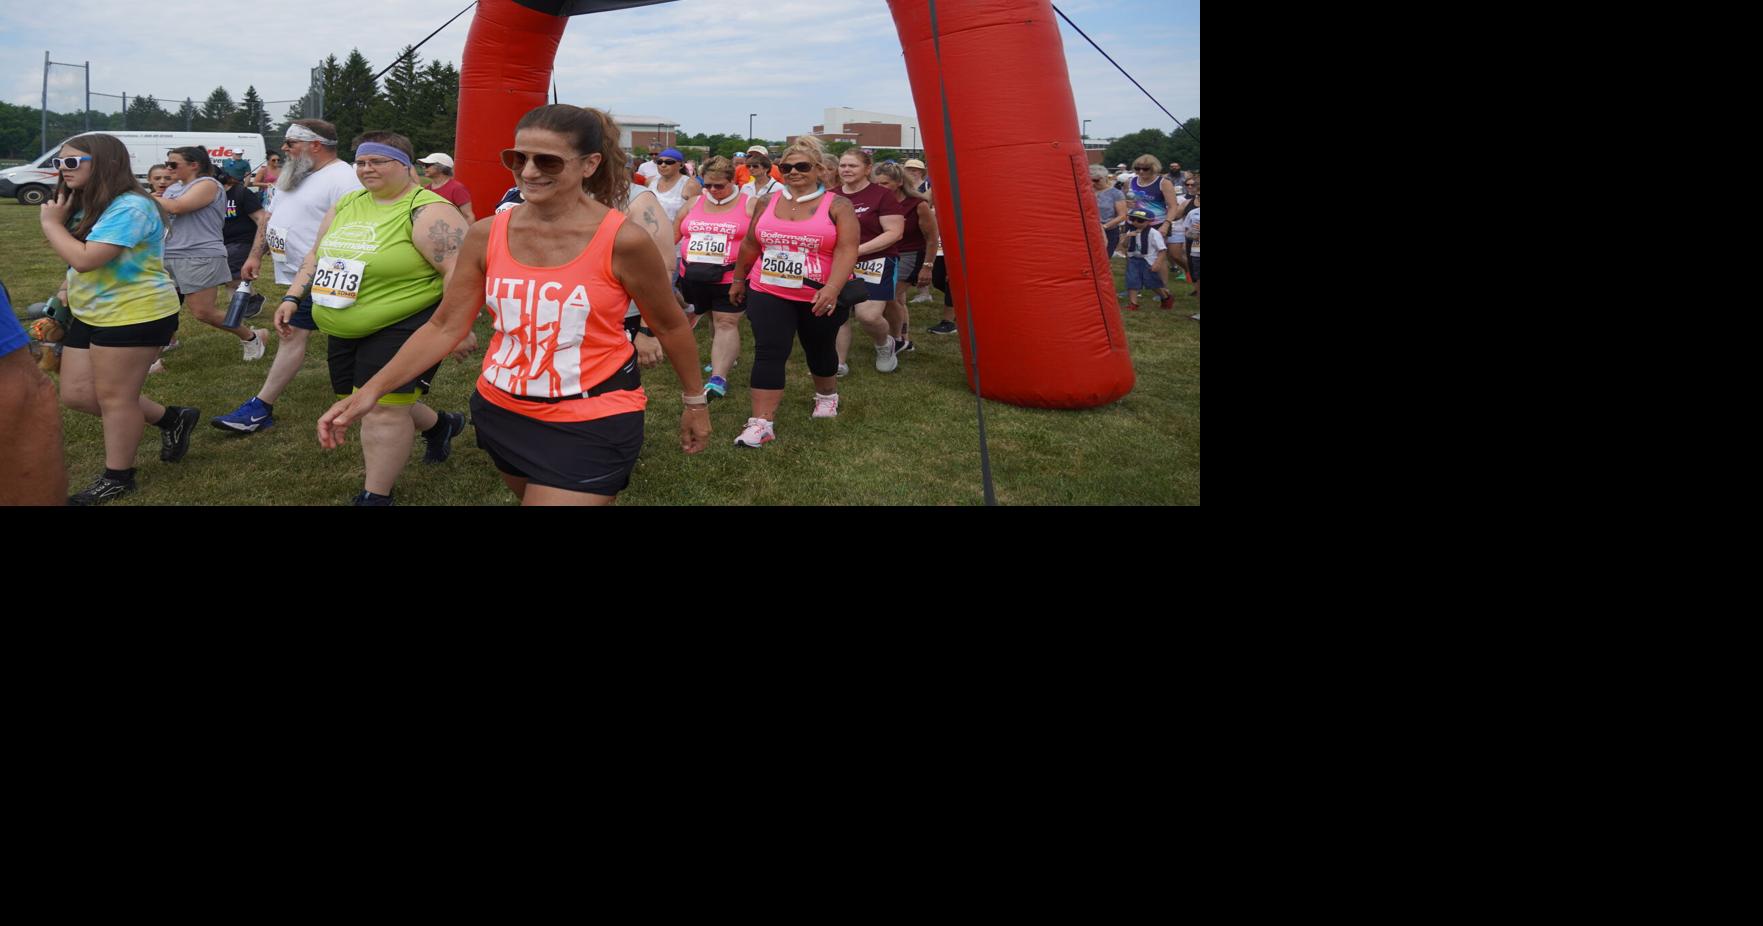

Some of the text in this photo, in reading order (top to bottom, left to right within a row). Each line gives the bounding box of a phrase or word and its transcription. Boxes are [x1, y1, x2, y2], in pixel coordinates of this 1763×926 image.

[760, 231, 820, 243] Boilermaker
[690, 241, 725, 253] 25150
[763, 258, 803, 275] 25048
[314, 269, 359, 292] 25113
[486, 276, 590, 303] UTICA
